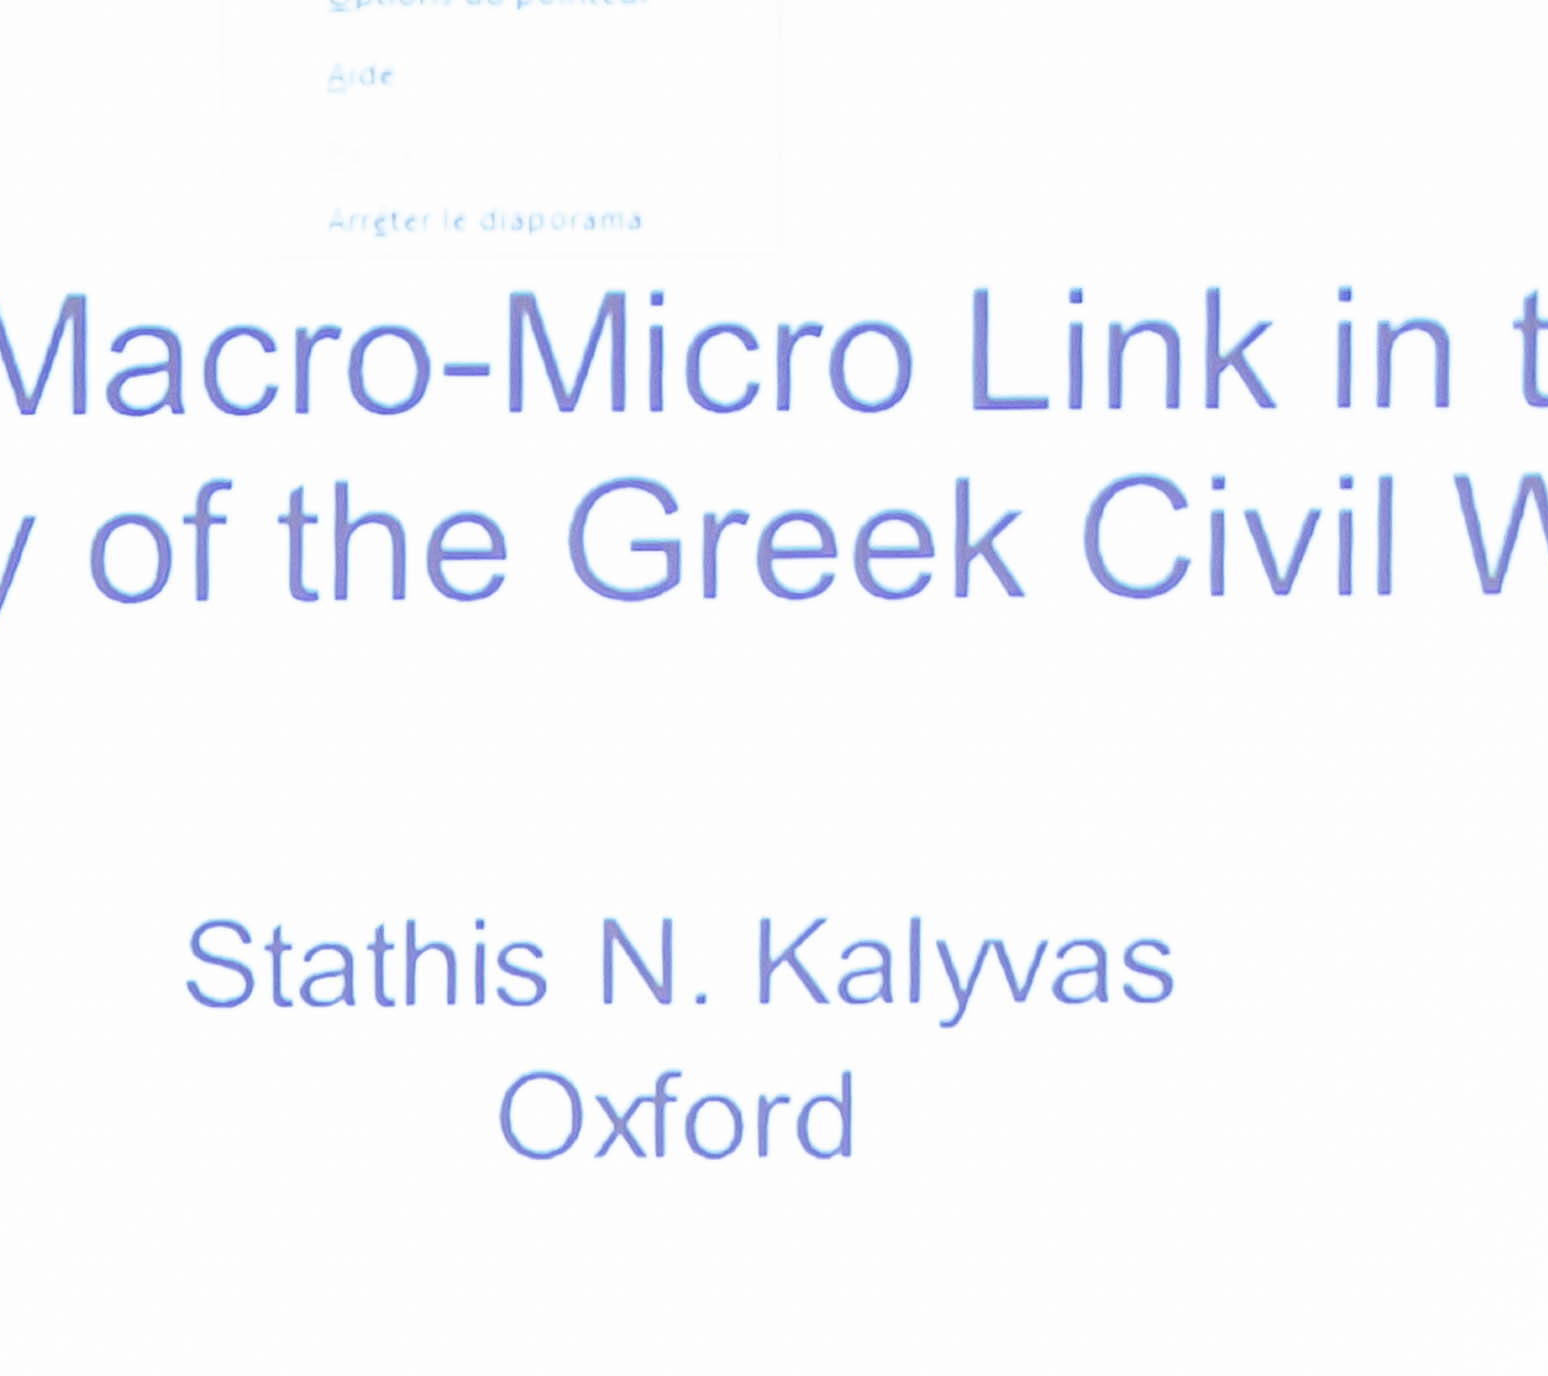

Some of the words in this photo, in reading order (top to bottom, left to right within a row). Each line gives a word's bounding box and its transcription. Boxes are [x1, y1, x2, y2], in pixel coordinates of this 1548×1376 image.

[328, 64, 395, 94] Aide
[444, 209, 468, 234] le
[480, 208, 645, 238] diaporama
[972, 285, 1280, 413] Link
[1336, 285, 1453, 411] in
[89, 477, 236, 606] of
[277, 479, 510, 605] the
[568, 475, 1028, 605] Greek
[1083, 472, 1396, 602] Civil
[186, 917, 549, 1010] Stathis
[602, 917, 709, 1007] N.
[758, 915, 1177, 1031] Kalyvas
[499, 1069, 855, 1162] Oxford
